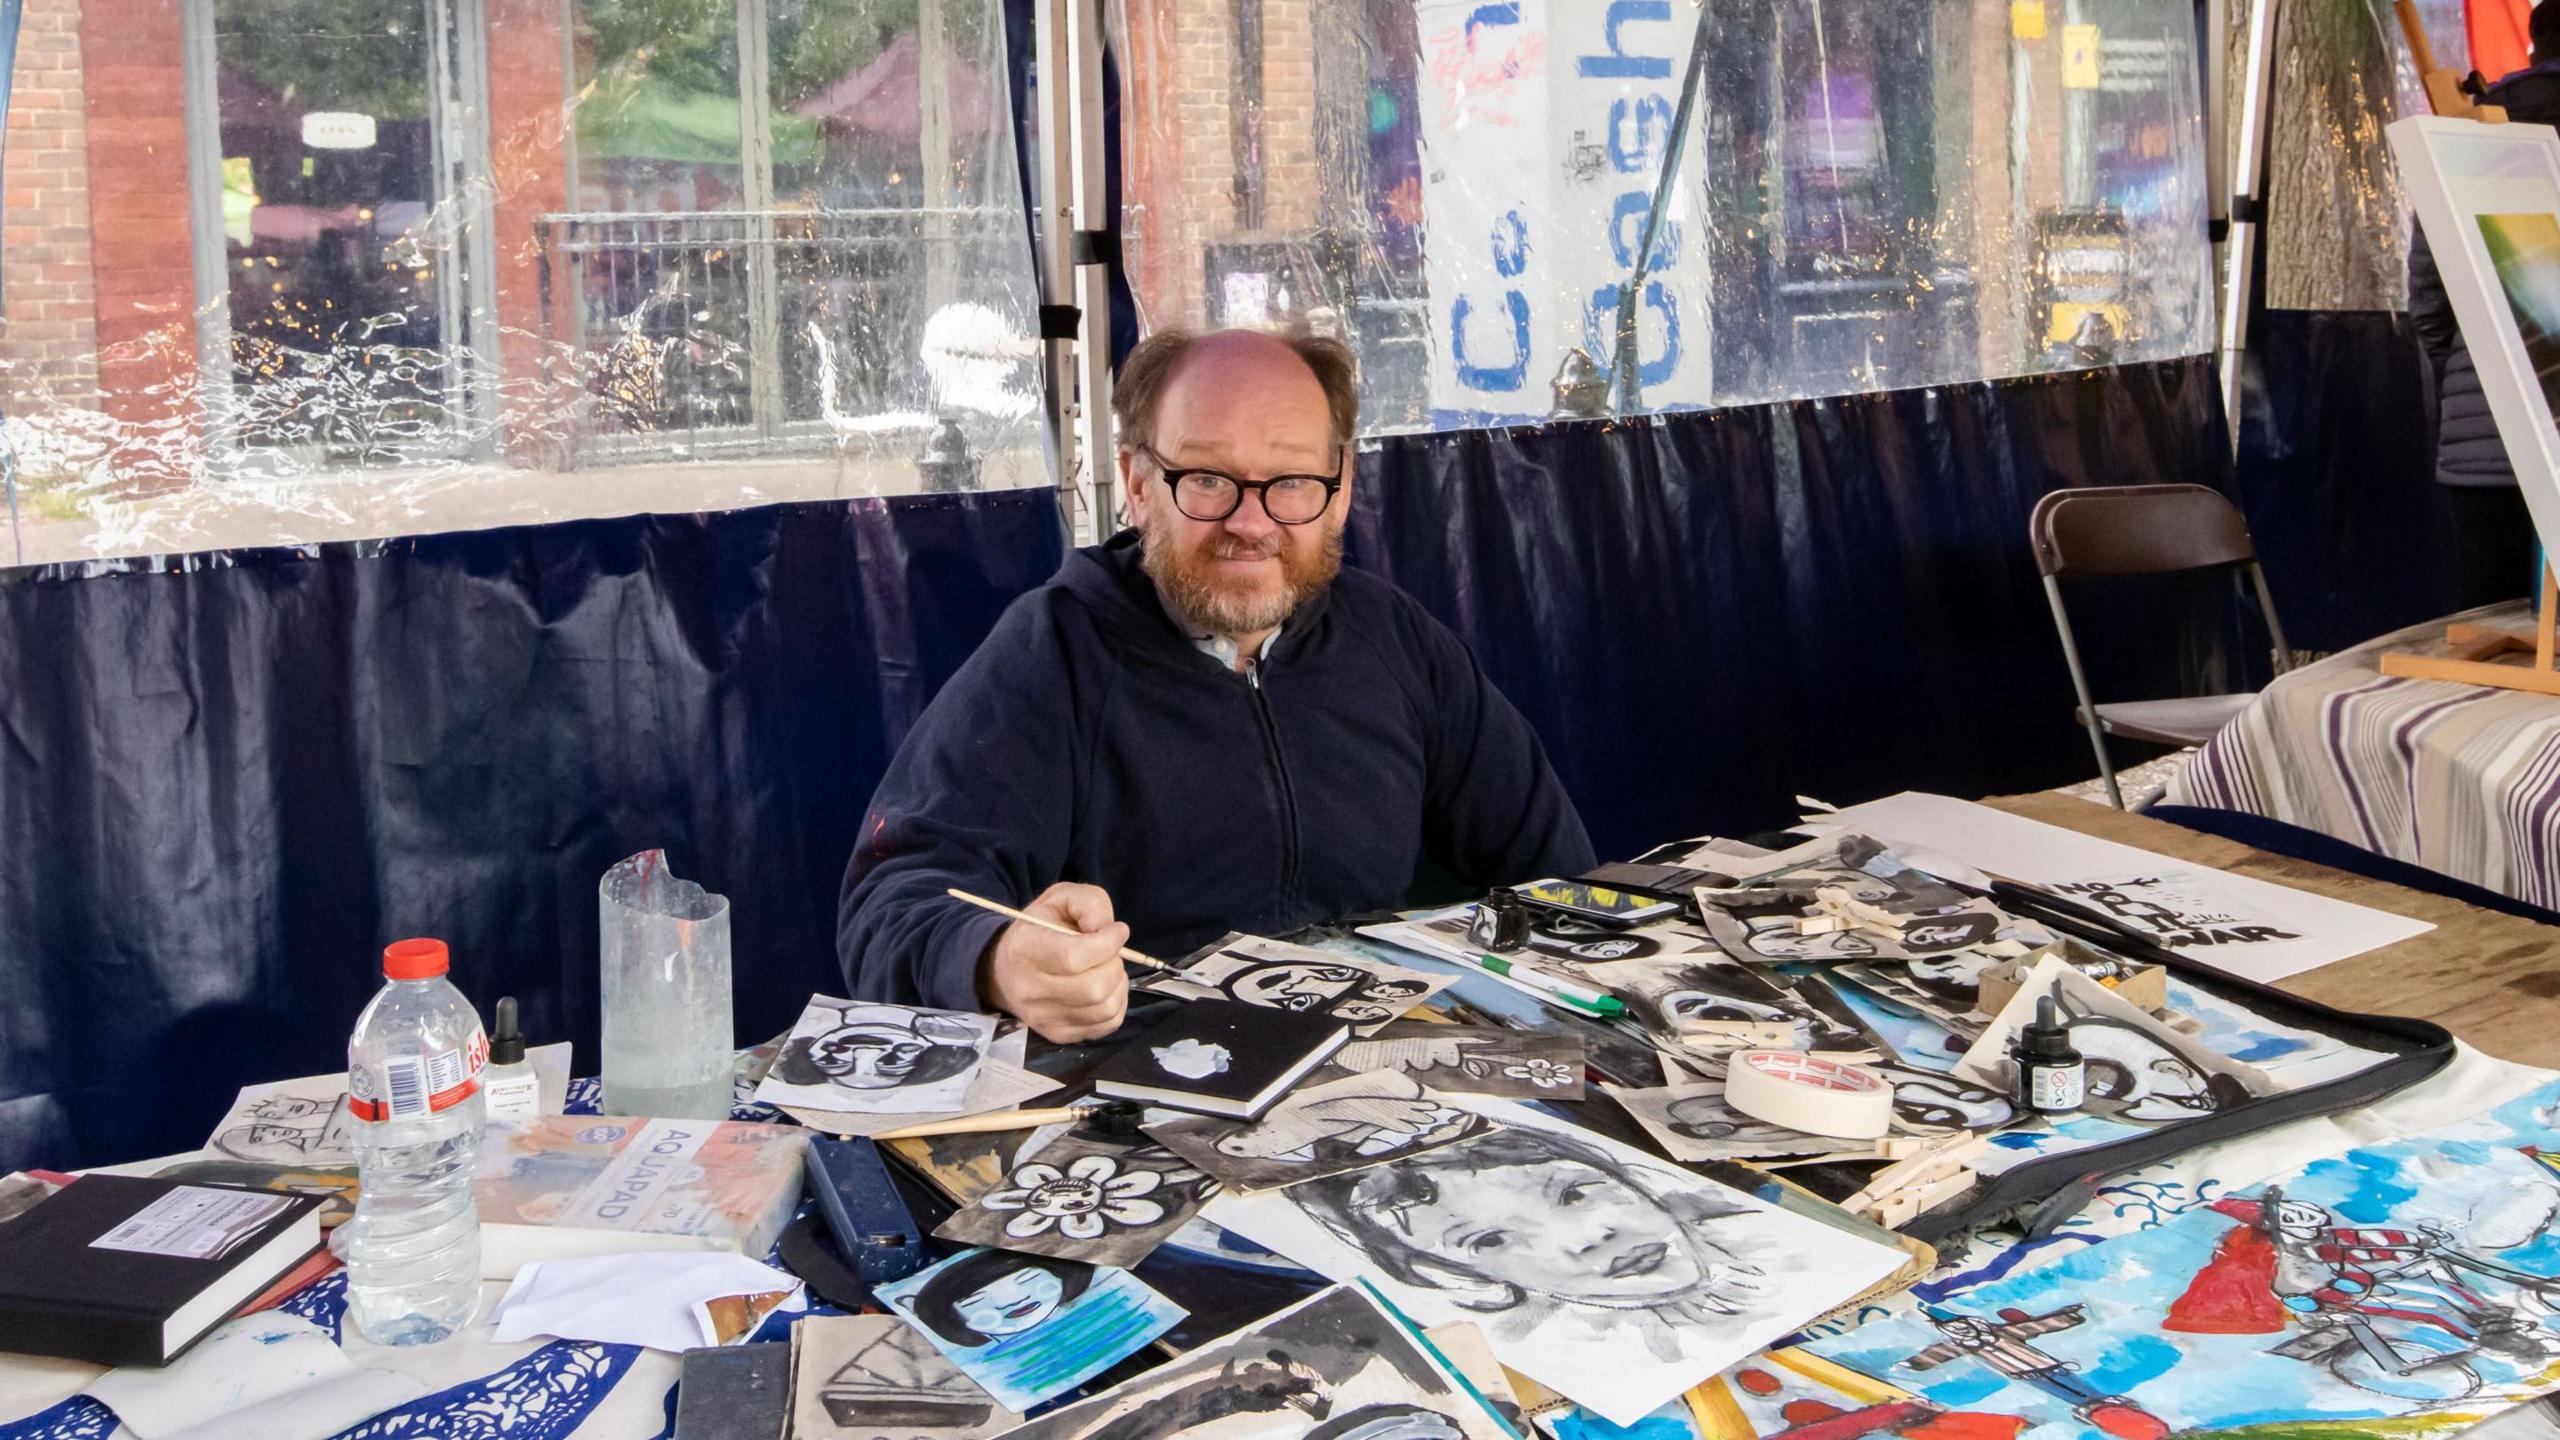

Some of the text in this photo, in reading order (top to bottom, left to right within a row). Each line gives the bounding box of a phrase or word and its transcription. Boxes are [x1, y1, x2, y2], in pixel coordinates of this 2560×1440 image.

[1577, 0, 1682, 388] Cash
[2050, 882, 2114, 895] NO
[2169, 926, 2302, 947] WAR
